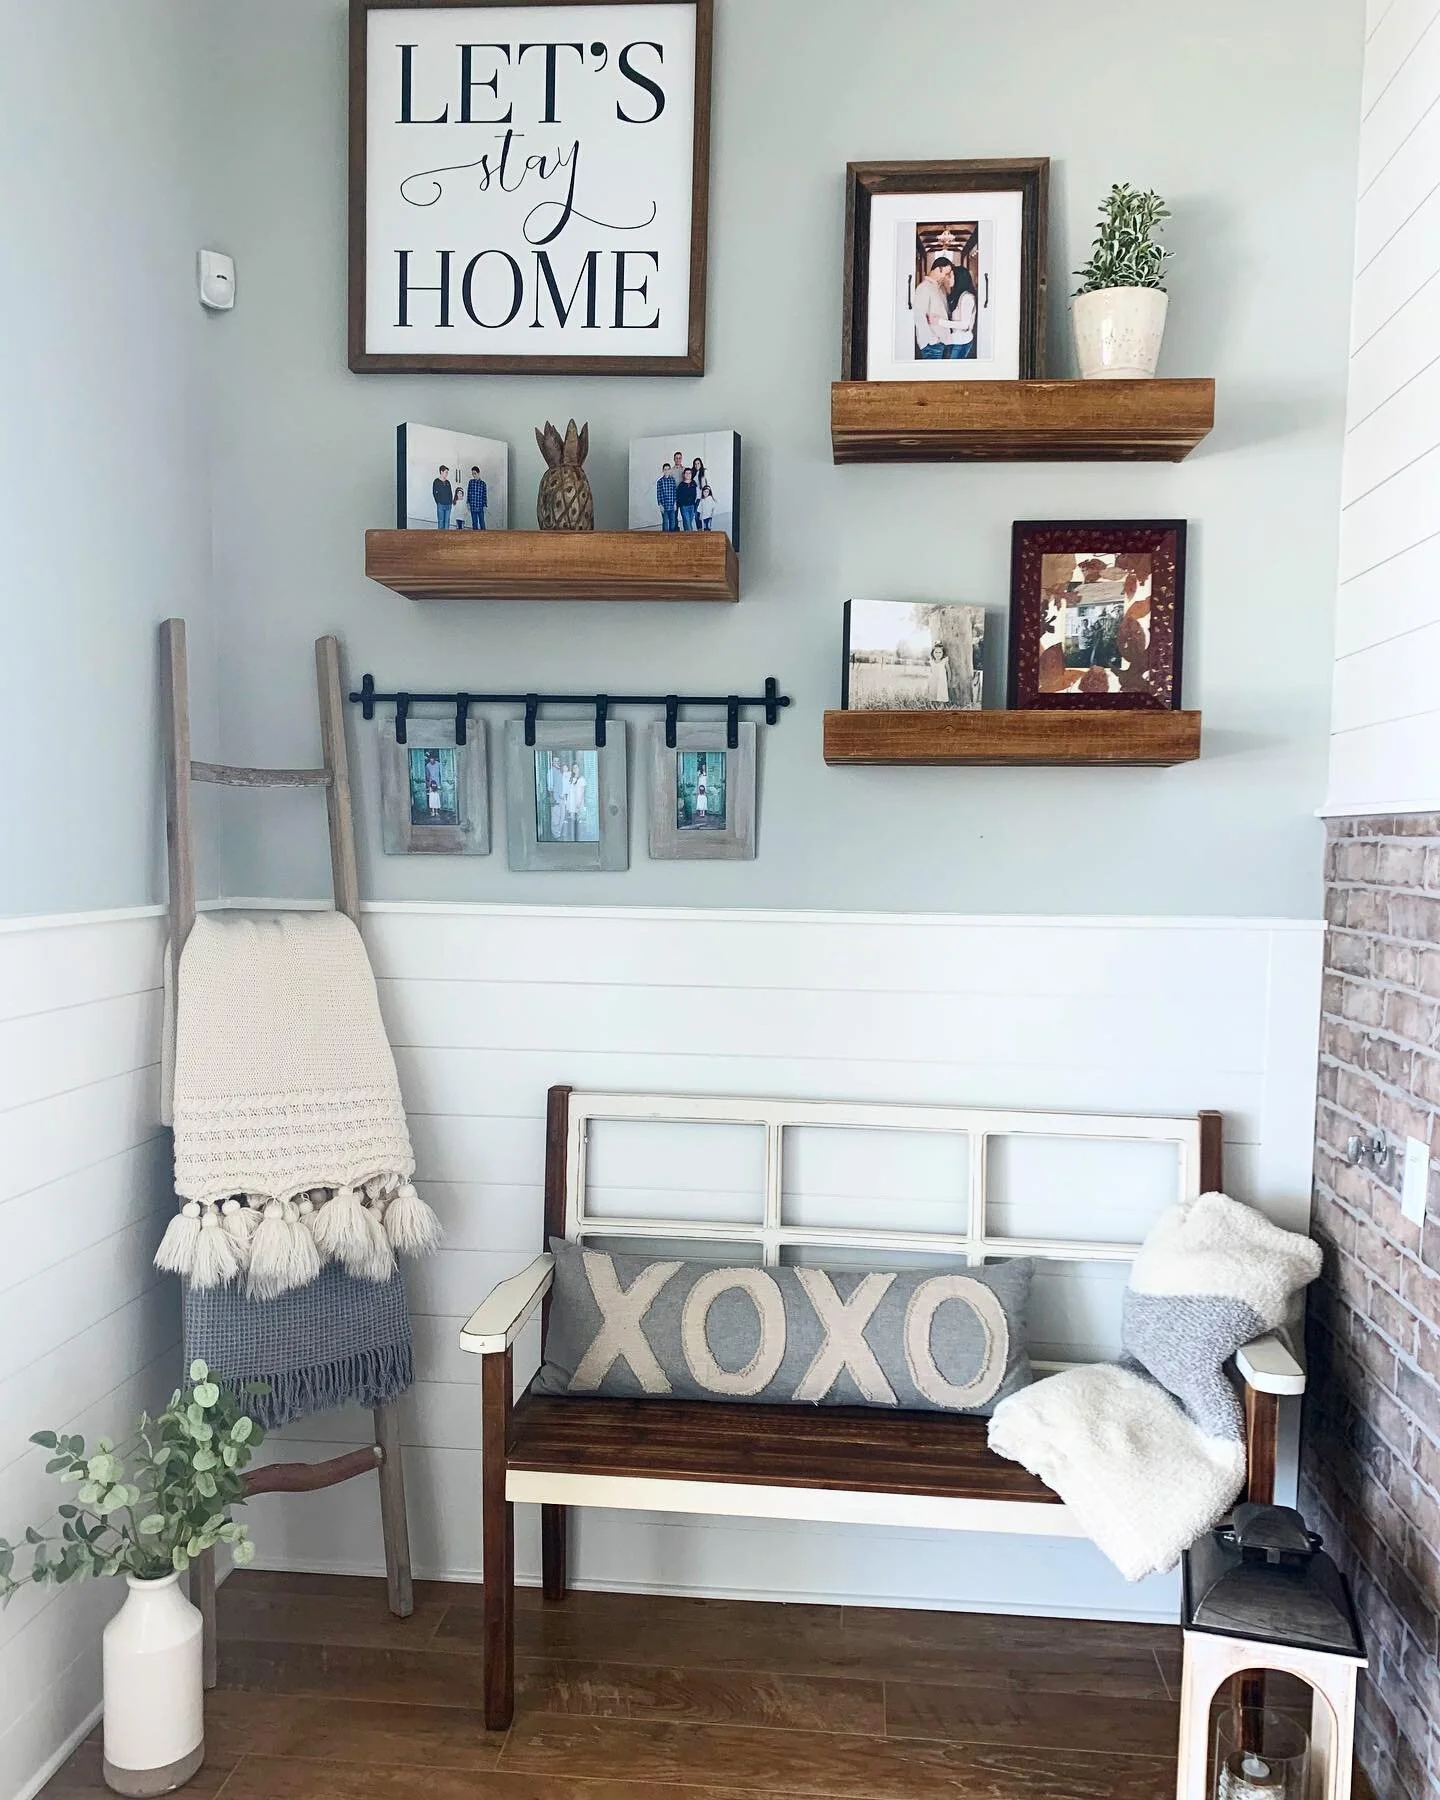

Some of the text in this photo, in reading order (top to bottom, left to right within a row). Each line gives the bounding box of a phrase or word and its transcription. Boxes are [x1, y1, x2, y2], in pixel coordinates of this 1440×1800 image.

[395, 41, 666, 124] LET'S
[400, 129, 656, 245] stay
[393, 249, 660, 329] HOME
[567, 1250, 1010, 1410] XOXO
